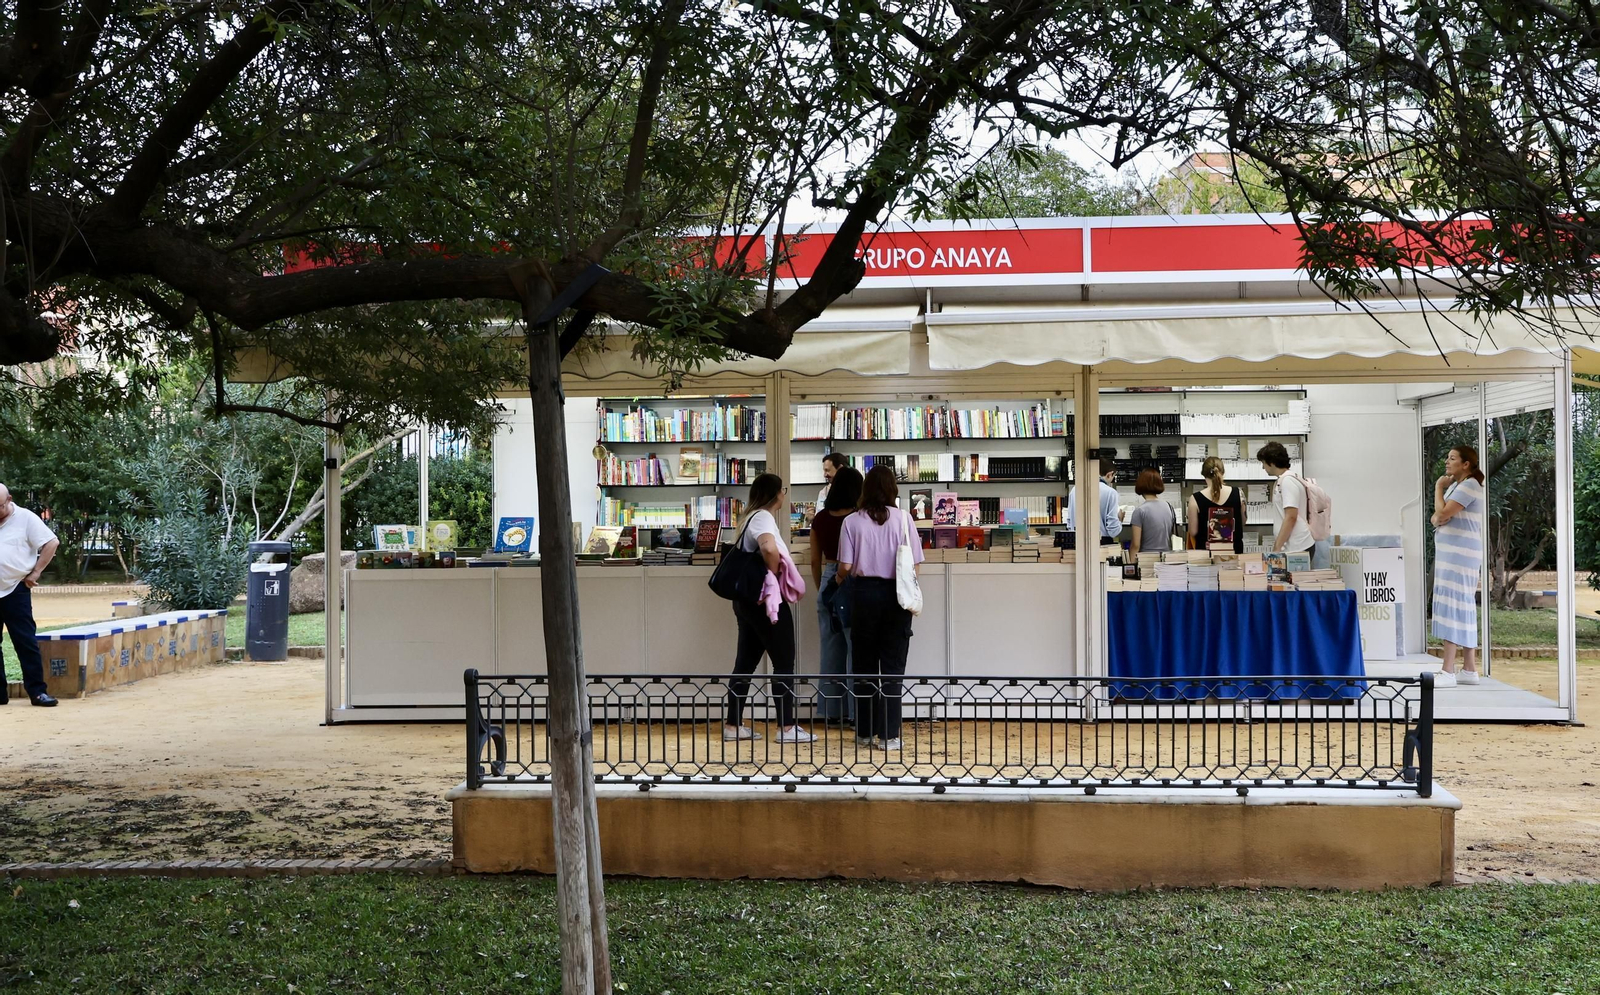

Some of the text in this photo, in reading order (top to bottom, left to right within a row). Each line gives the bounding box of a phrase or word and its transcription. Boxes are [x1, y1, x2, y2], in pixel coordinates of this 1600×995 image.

[930, 247, 1013, 268] ANAYA
[1329, 548, 1360, 564] Y LIBROS
[1363, 571, 1388, 587] Y HAY
[1365, 588, 1395, 603] LIBROS
